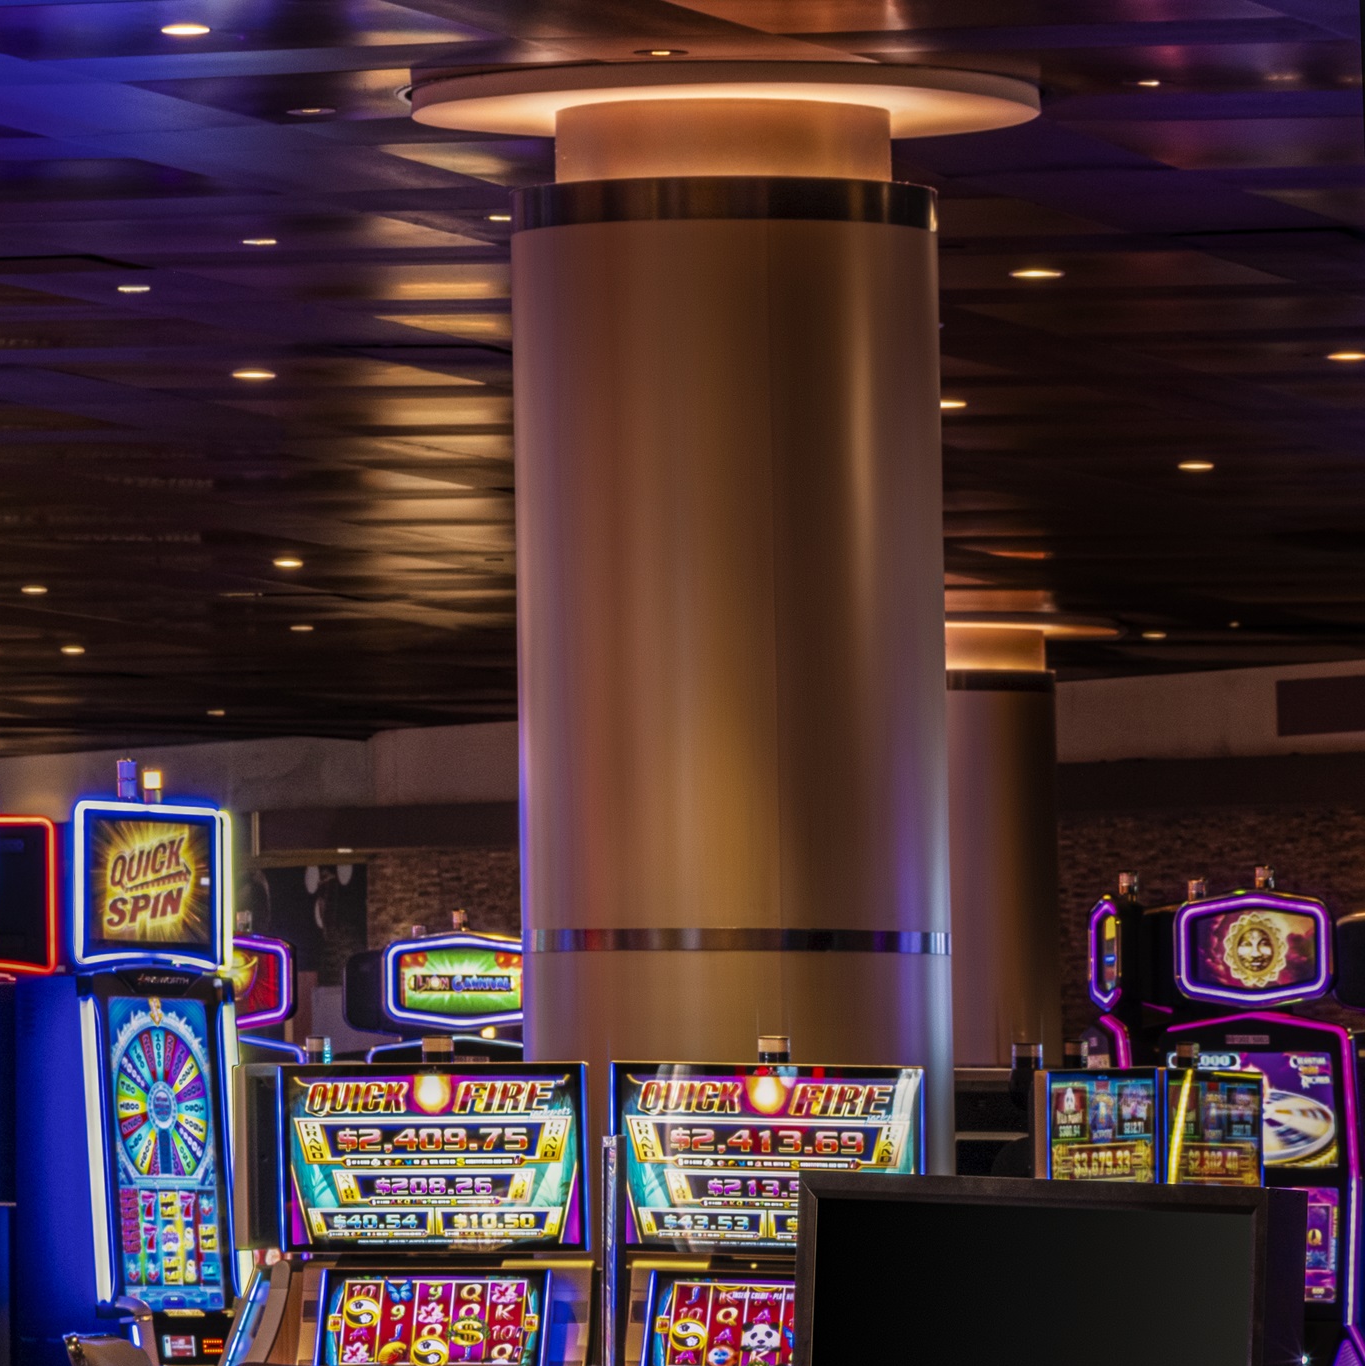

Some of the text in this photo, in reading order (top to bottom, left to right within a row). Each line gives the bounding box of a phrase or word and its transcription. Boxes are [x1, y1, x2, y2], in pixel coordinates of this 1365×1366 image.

[110, 836, 186, 889] QUICK
[106, 887, 184, 928] SPIN
[452, 975, 509, 992] CARNIVAL
[305, 1080, 556, 1116] QUICK FIRE
[638, 1080, 894, 1117] QUICK FIRE
[336, 1127, 528, 1153] $2,409.75
[670, 1127, 865, 1155] $2,413.69
[375, 1177, 492, 1195] $208.26
[333, 1213, 418, 1230] $40.54
[453, 1212, 535, 1230] $10.50
[664, 1214, 749, 1231] $43.53
